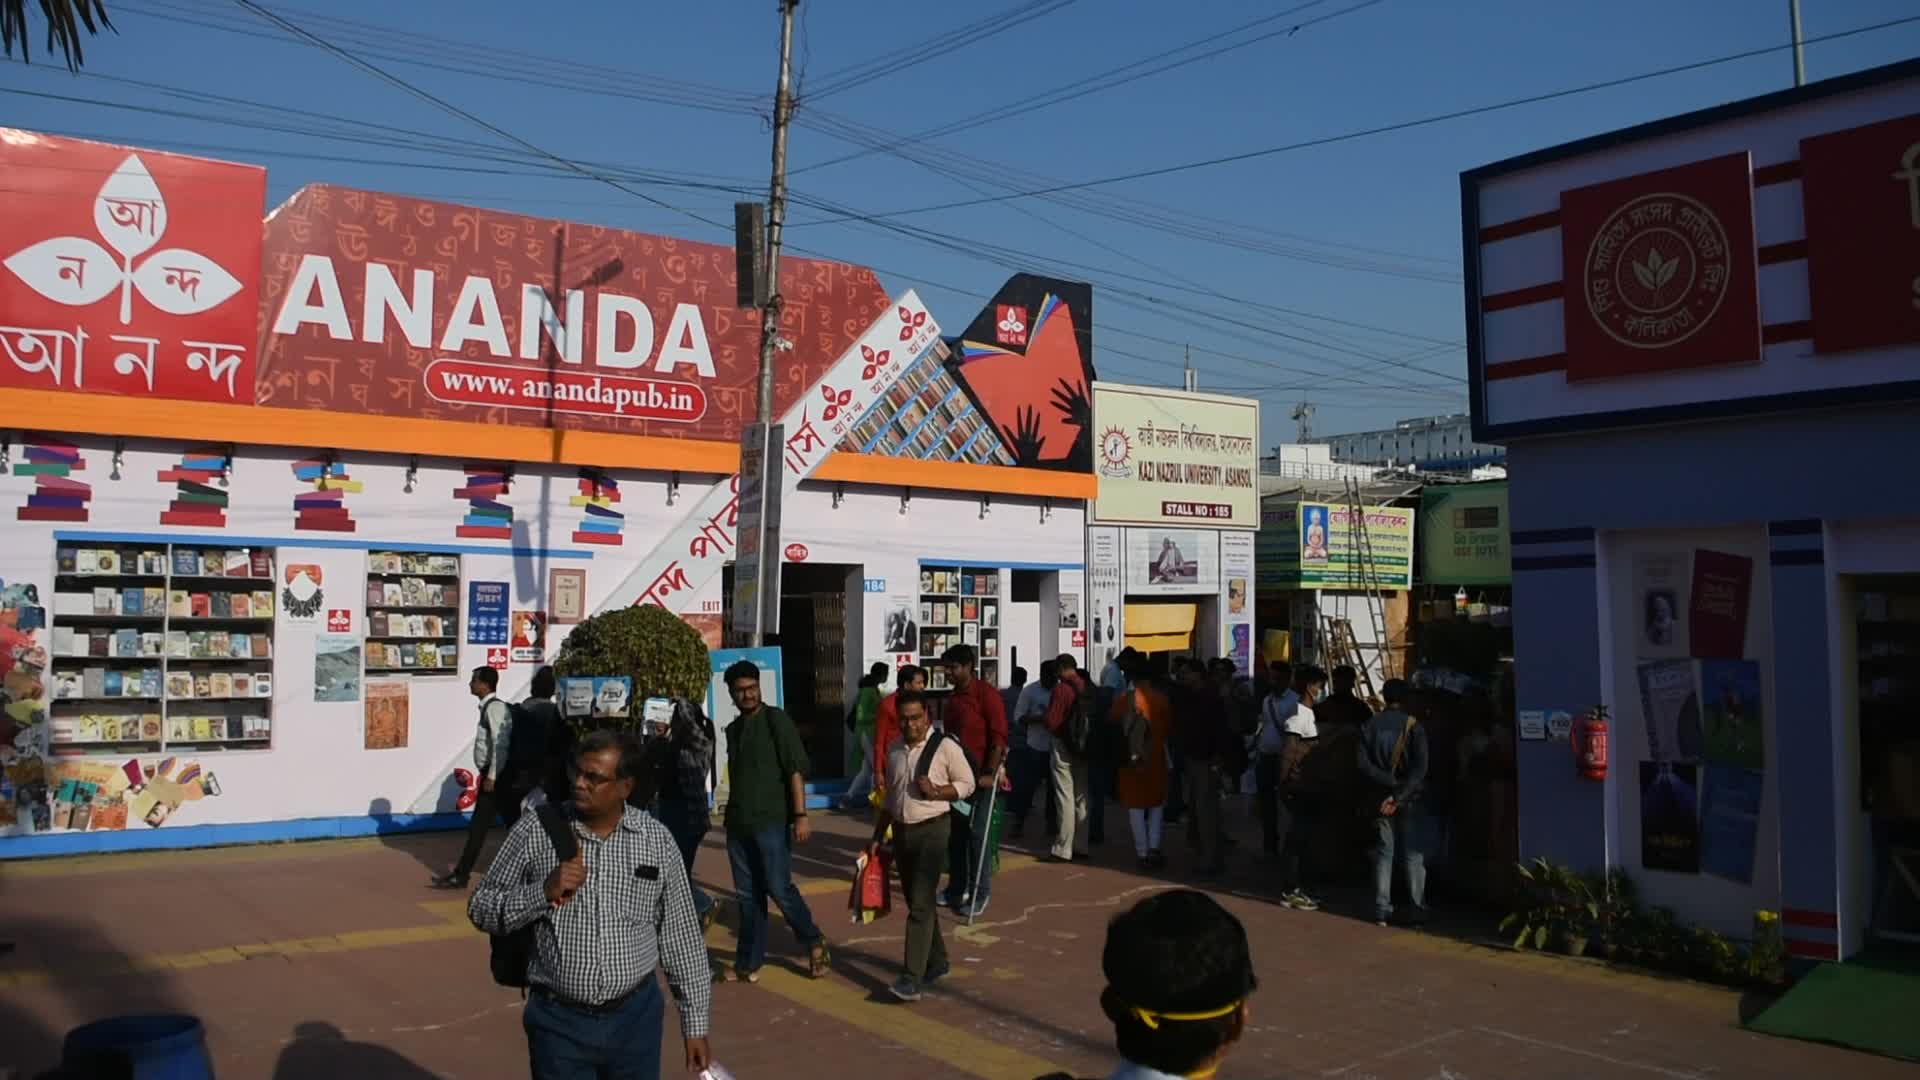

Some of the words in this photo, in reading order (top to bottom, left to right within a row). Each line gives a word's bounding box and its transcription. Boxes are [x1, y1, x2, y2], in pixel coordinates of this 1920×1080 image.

[273, 255, 716, 378] ANANDA
[441, 371, 515, 396] www.
[522, 376, 694, 413] anandapub.in
[1138, 461, 1155, 483] KAZI
[1156, 462, 1183, 485] NAZRUL
[1224, 467, 1253, 489] ASANSOL
[1165, 503, 1194, 516] STALL
[865, 581, 886, 593] 184
[702, 601, 720, 613] EXIT
